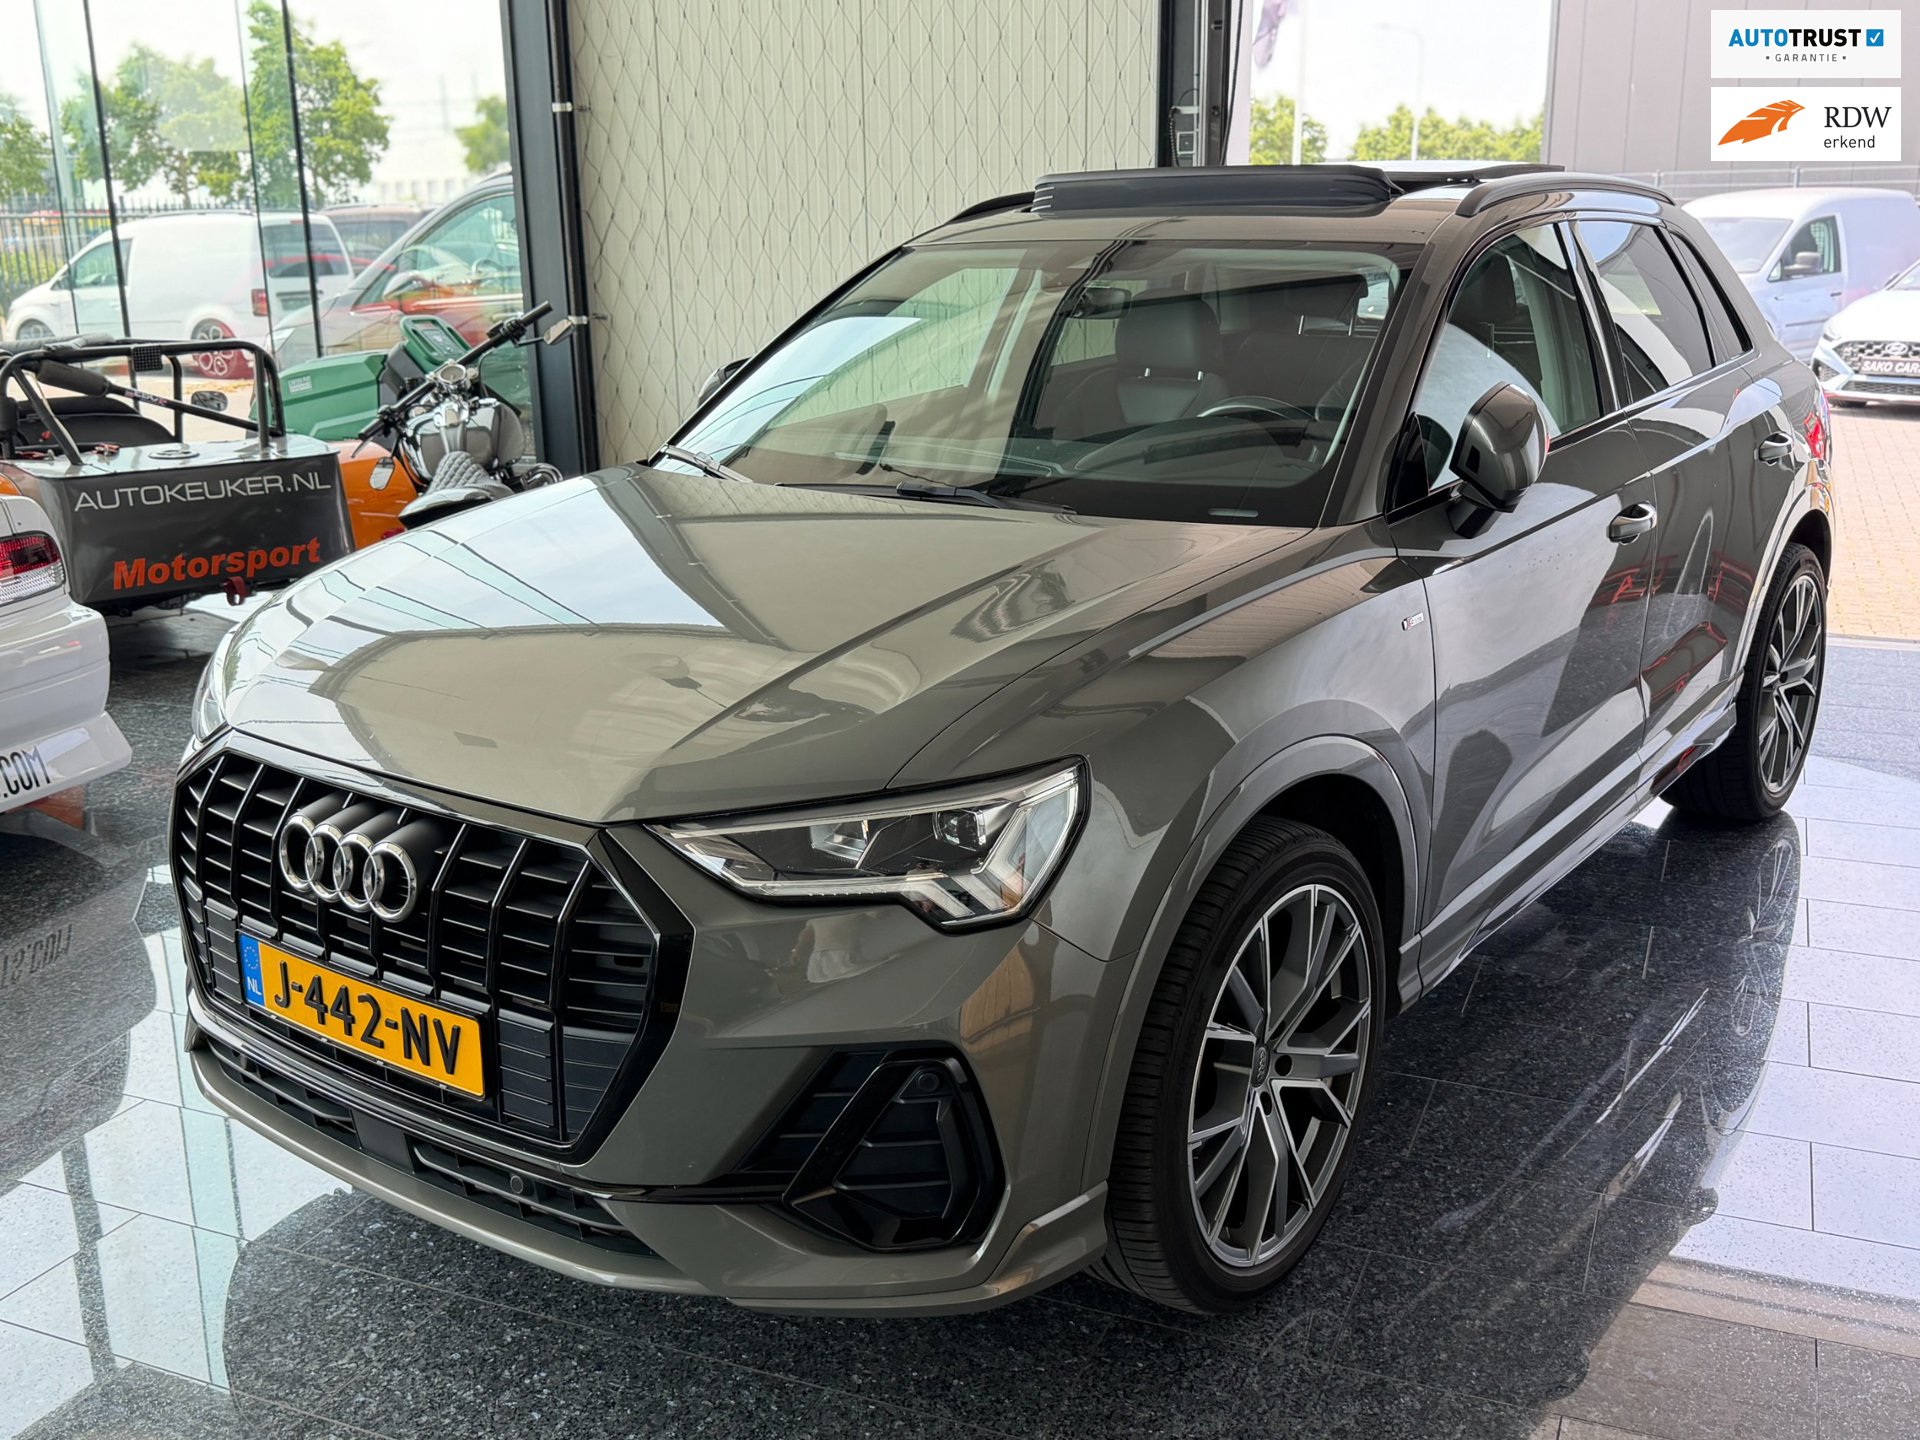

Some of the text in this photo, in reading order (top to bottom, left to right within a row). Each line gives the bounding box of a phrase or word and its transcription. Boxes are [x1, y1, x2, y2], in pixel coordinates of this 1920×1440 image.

[1861, 360, 1894, 372] SAKO
[74, 472, 331, 512] AUTOKEUKER.NL
[113, 536, 320, 591] Motorsport
[0, 745, 51, 798] .COM
[247, 976, 262, 996] NL
[274, 960, 461, 1075] J-442-NV
